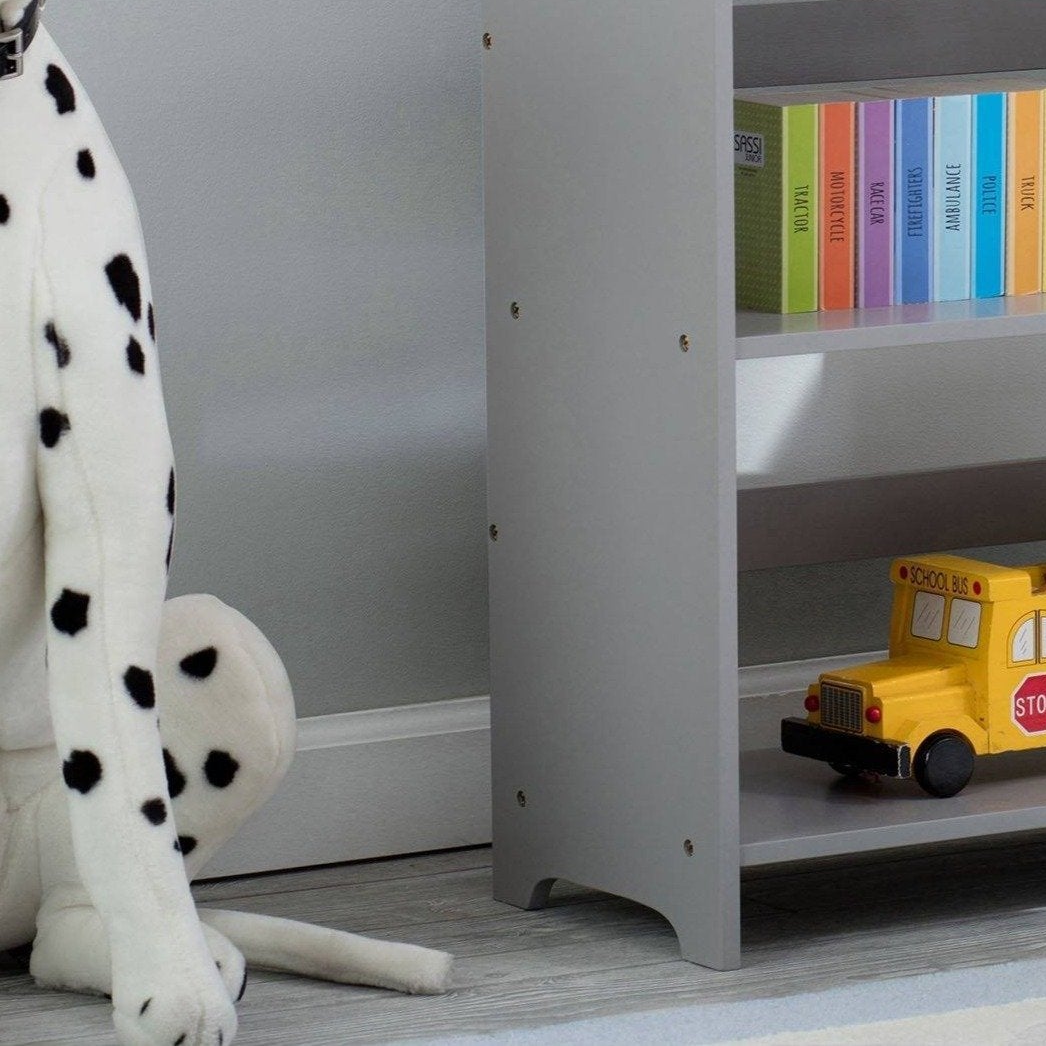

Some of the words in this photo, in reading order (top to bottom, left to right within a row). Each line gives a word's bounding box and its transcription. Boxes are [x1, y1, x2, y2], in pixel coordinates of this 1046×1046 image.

[734, 134, 762, 155] SASSI
[793, 184, 809, 234] TRACTOR
[830, 171, 845, 243] MOTORCYCLE
[945, 162, 961, 232] AMBULANCE
[981, 175, 997, 216] POLICE
[1020, 176, 1035, 211] TRUCK
[910, 566, 949, 592] SCHOOL
[952, 574, 969, 595] BUS
